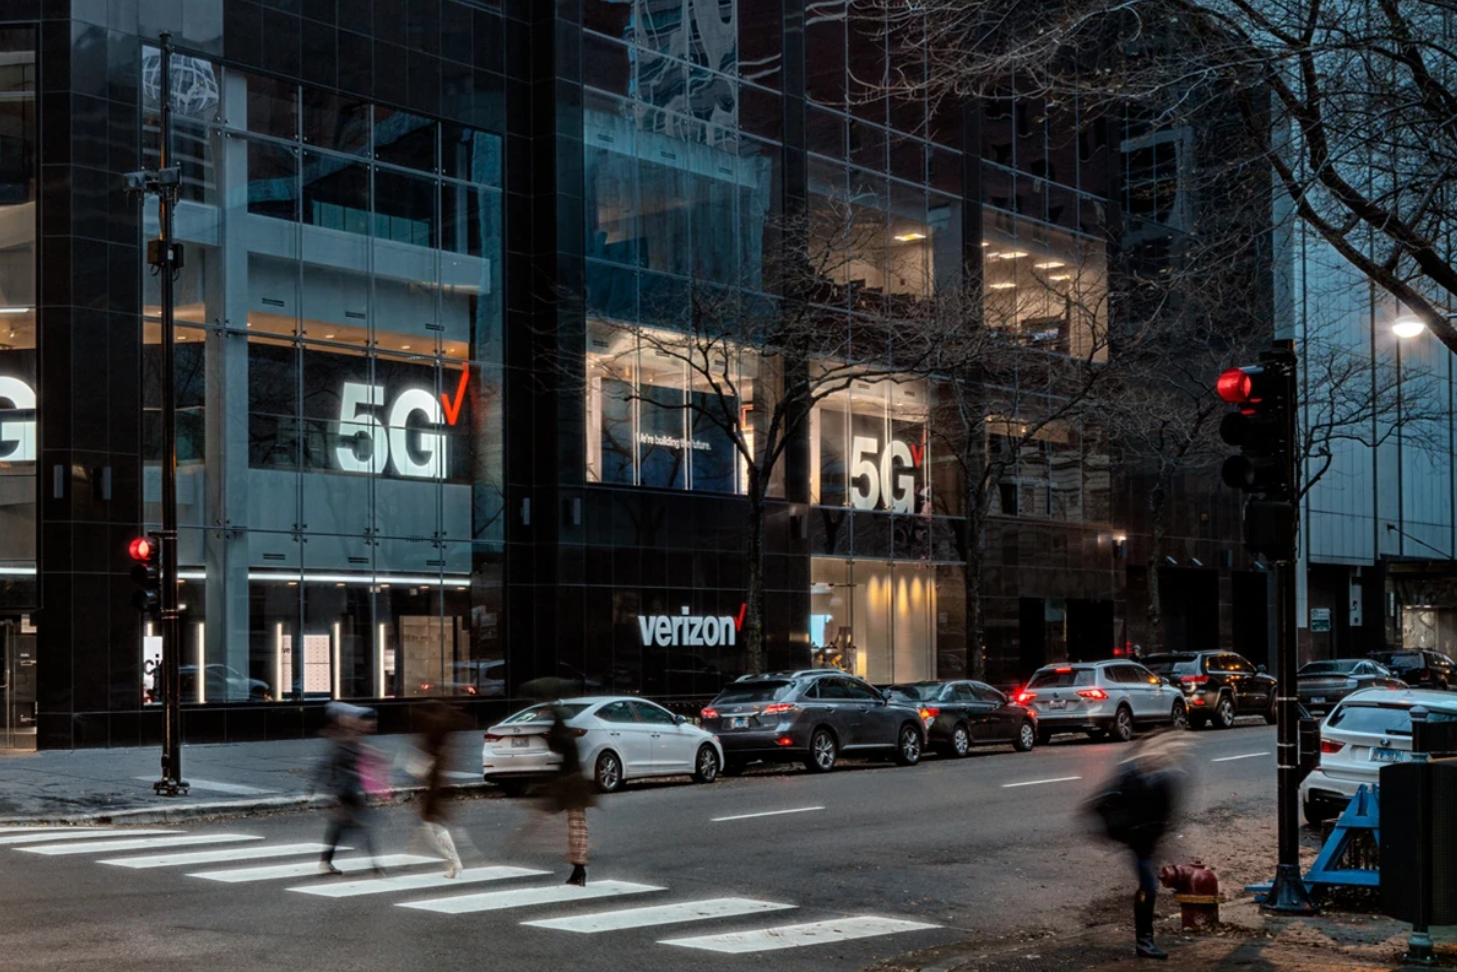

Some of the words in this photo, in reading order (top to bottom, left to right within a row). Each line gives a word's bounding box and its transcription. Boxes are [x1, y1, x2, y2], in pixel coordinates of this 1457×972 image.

[336, 382, 447, 479] 5G
[849, 435, 914, 514] 5G
[638, 606, 736, 647] verizon
